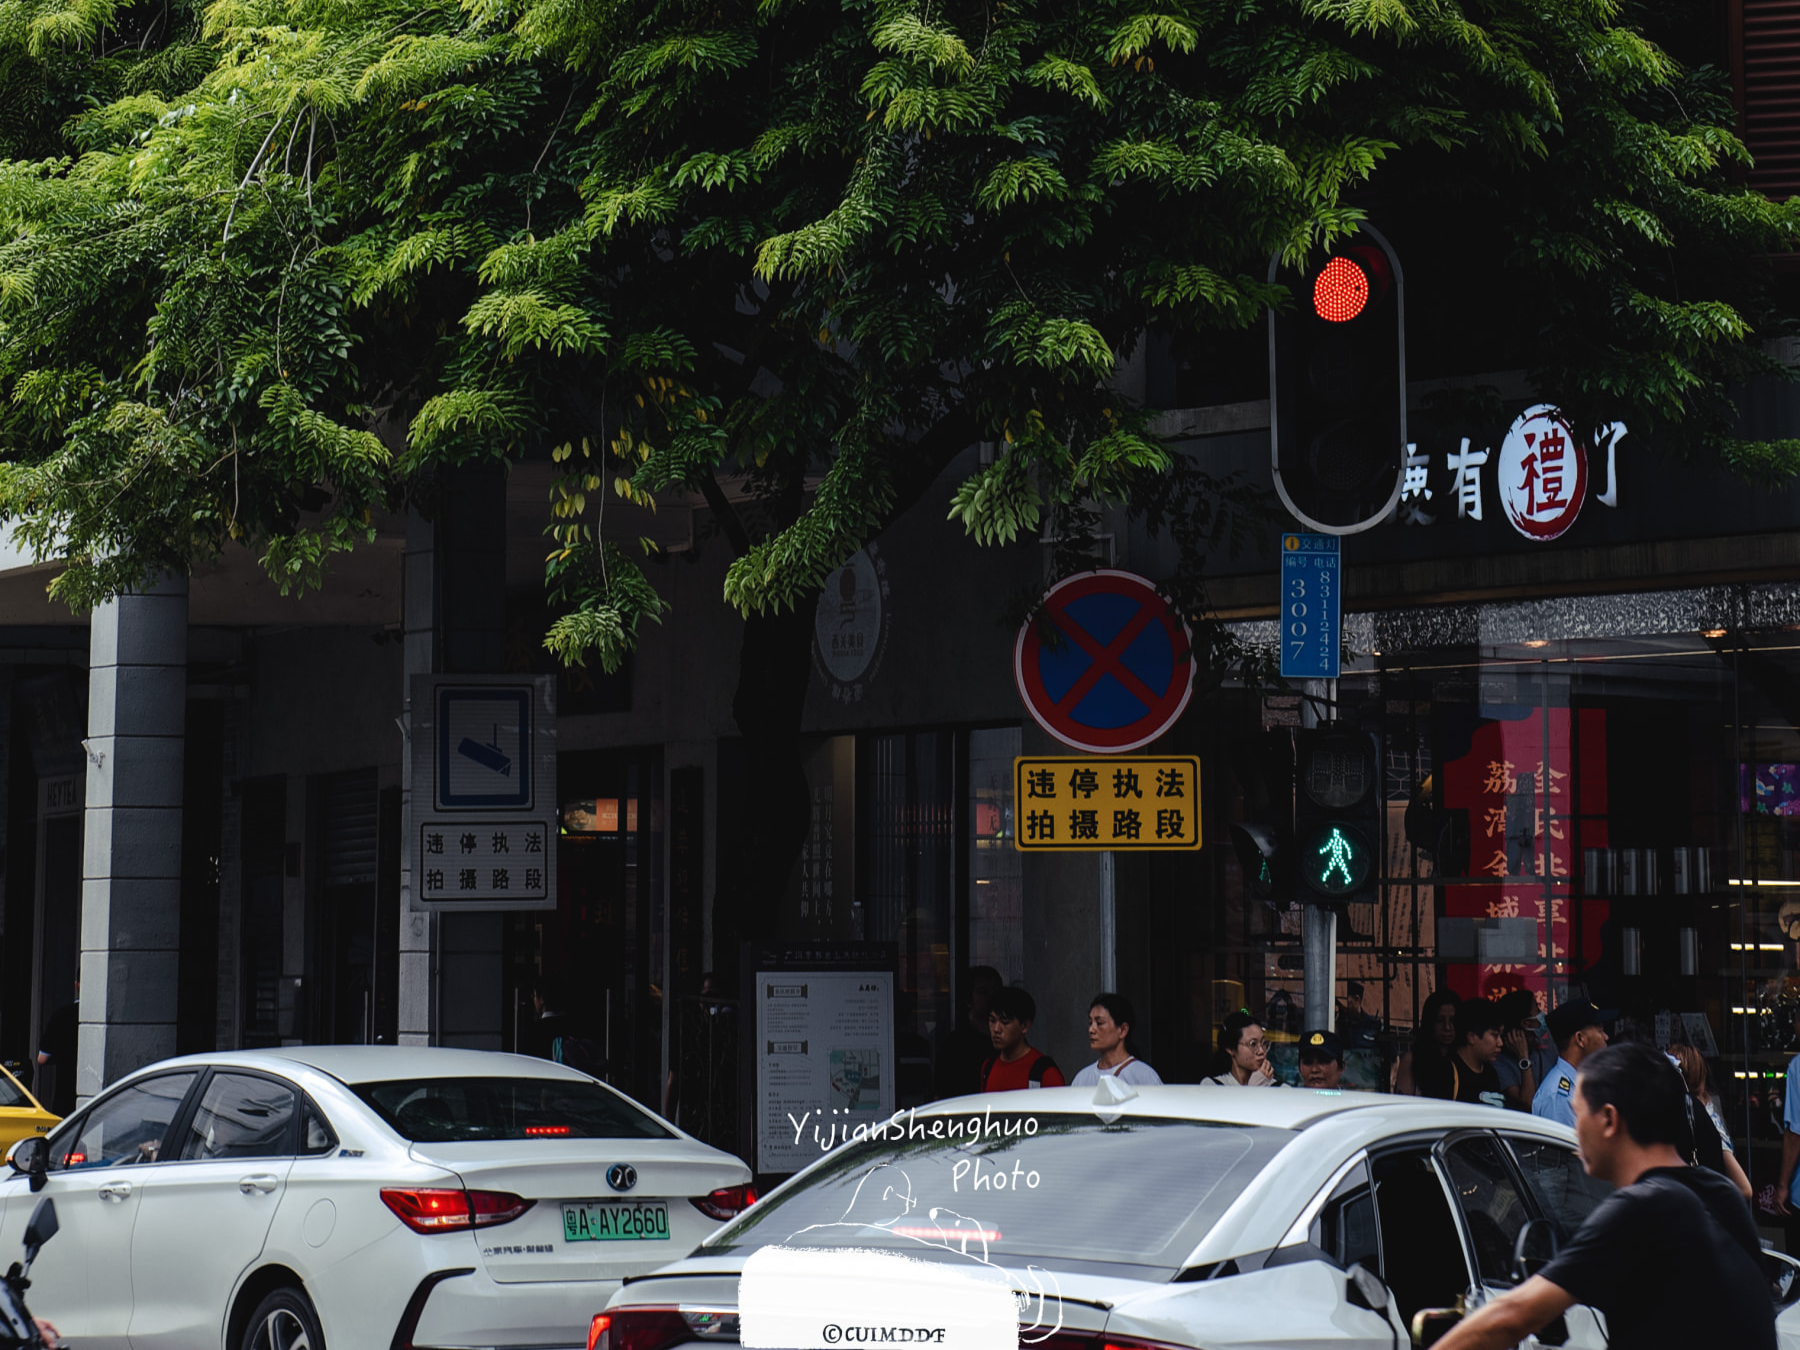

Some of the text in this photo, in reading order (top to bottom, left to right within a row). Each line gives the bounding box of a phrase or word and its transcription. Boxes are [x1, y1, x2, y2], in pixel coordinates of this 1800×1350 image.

[1301, 538, 1337, 550] 交通灯
[1285, 557, 1337, 569] 编号 电话
[1291, 578, 1308, 661] 3007
[1319, 571, 1331, 671] 83112424
[47, 778, 77, 807] HEYTEA
[1027, 768, 1185, 799] 违停执法
[1027, 809, 1185, 839] 拍摄路段
[426, 831, 541, 854] 违停执法
[426, 868, 541, 891] 拍摄路段
